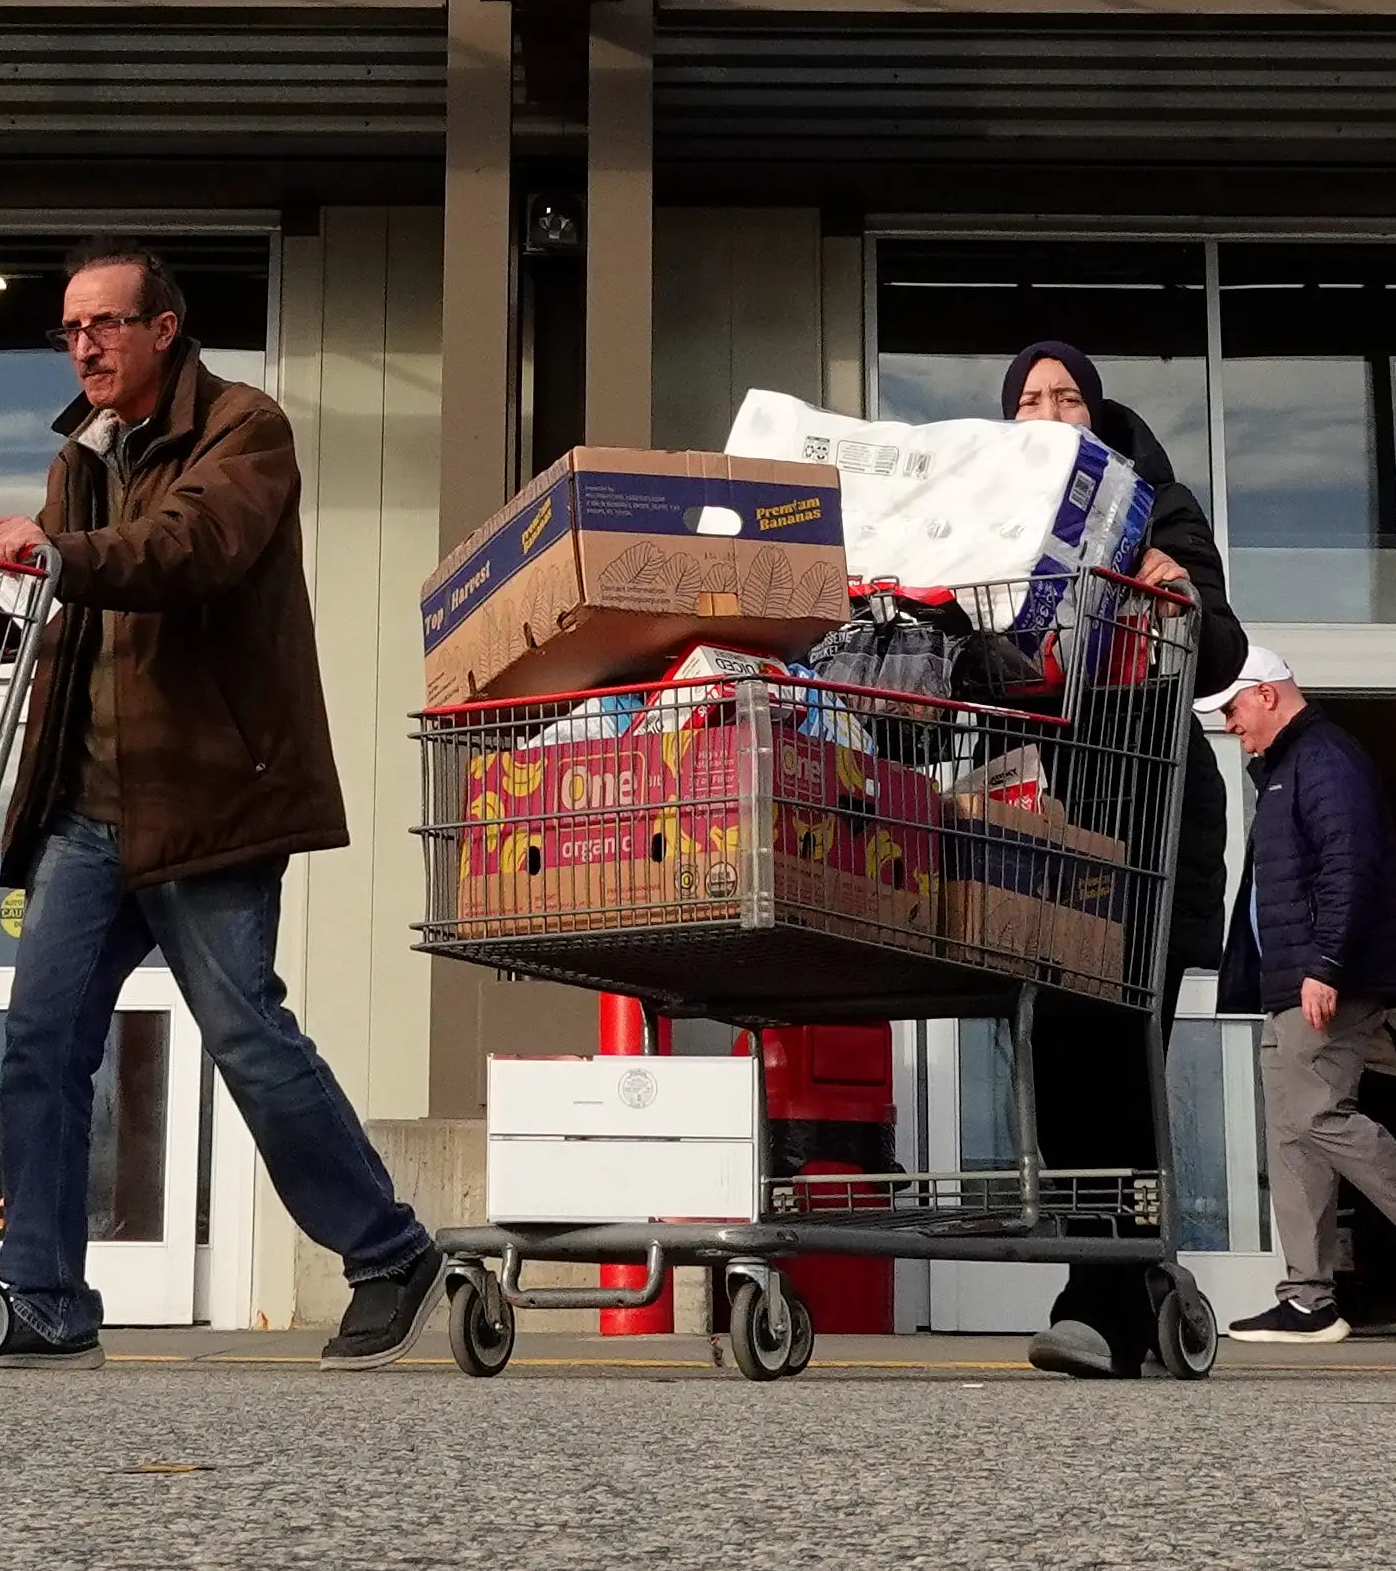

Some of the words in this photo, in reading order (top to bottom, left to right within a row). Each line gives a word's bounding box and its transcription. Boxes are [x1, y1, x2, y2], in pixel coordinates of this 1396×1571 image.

[759, 509, 822, 531] Bananas
[425, 607, 444, 636] Top
[450, 560, 491, 612] Harvest
[560, 765, 638, 810] One
[562, 833, 632, 862] organc
